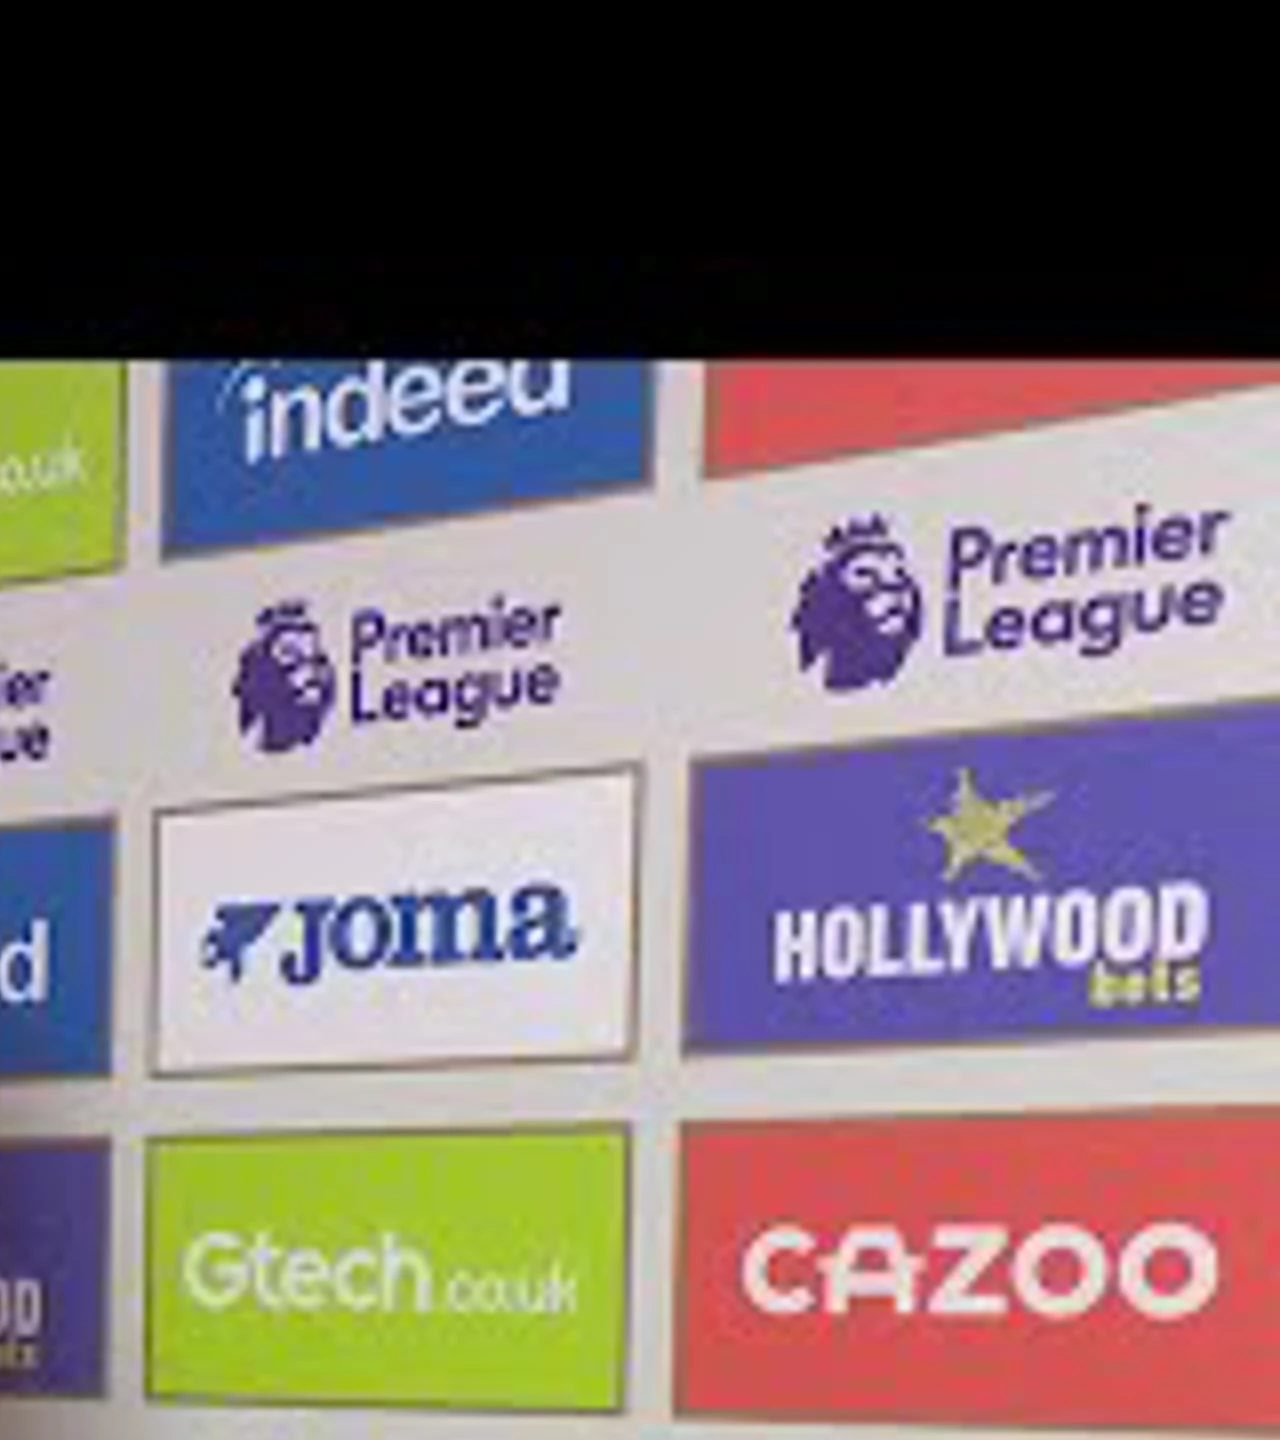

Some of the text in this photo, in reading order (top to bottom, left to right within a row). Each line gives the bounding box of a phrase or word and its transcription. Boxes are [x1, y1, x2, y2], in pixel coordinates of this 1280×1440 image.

[950, 503, 1231, 594] Premier
[349, 598, 562, 668] Premier
[942, 567, 1226, 657] League
[349, 659, 562, 730] League
[774, 882, 1208, 984] HOLLYWOOD
[1088, 958, 1202, 1010] bets
[181, 1232, 577, 1314] Gtech.co.uk
[742, 1222, 1218, 1320] CAZOO
